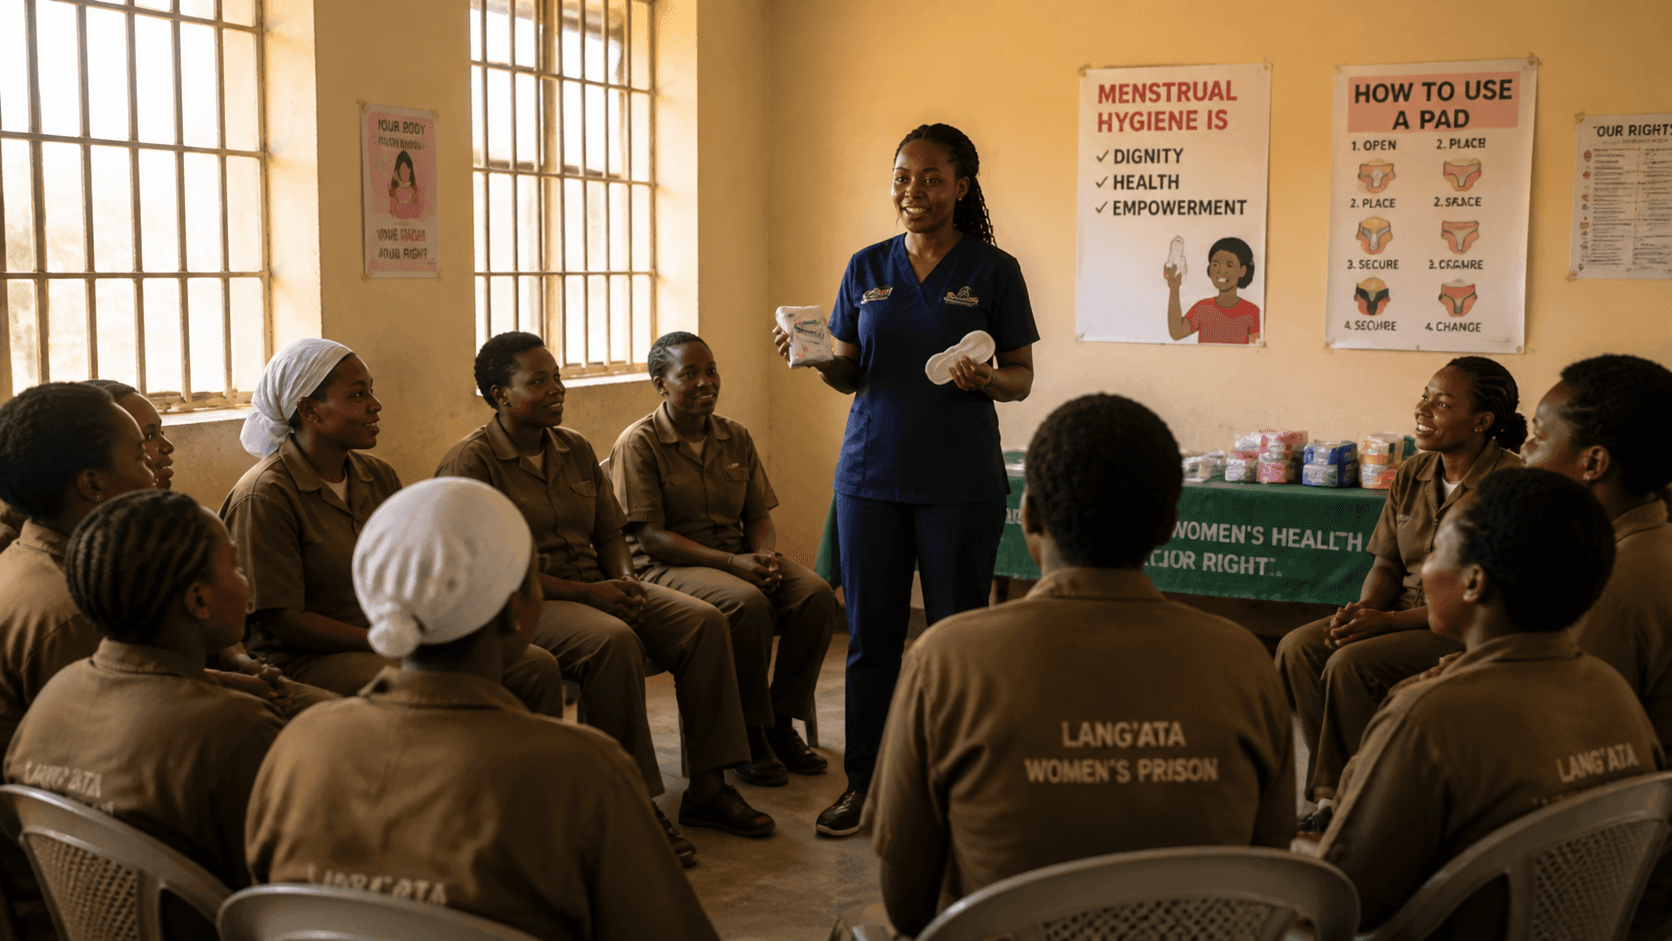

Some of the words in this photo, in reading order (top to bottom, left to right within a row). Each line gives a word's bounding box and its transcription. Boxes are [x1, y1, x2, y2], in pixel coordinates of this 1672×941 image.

[1097, 80, 1238, 104] MENSTRUAL
[1354, 82, 1414, 104] HOW
[1421, 81, 1455, 102] TO
[1464, 79, 1513, 101] USE
[1097, 110, 1198, 132] HYGIENE
[1207, 109, 1229, 131] IS
[1392, 110, 1410, 130] A
[1419, 109, 1470, 129] PAD
[1363, 140, 1397, 151] OPEN
[1113, 148, 1184, 164] DIGNITY
[1113, 174, 1180, 190] HEALTH
[1112, 200, 1248, 216] EMPOWERMENT
[1362, 198, 1396, 209] PLACE
[1358, 259, 1399, 270] SECURE
[1436, 321, 1482, 333] CHANGE
[1061, 720, 1187, 748] LANG'ATA
[1024, 758, 1131, 784] WOMEN'S
[1137, 757, 1219, 783] PRISON
[1556, 742, 1640, 784] LANG'ATA
